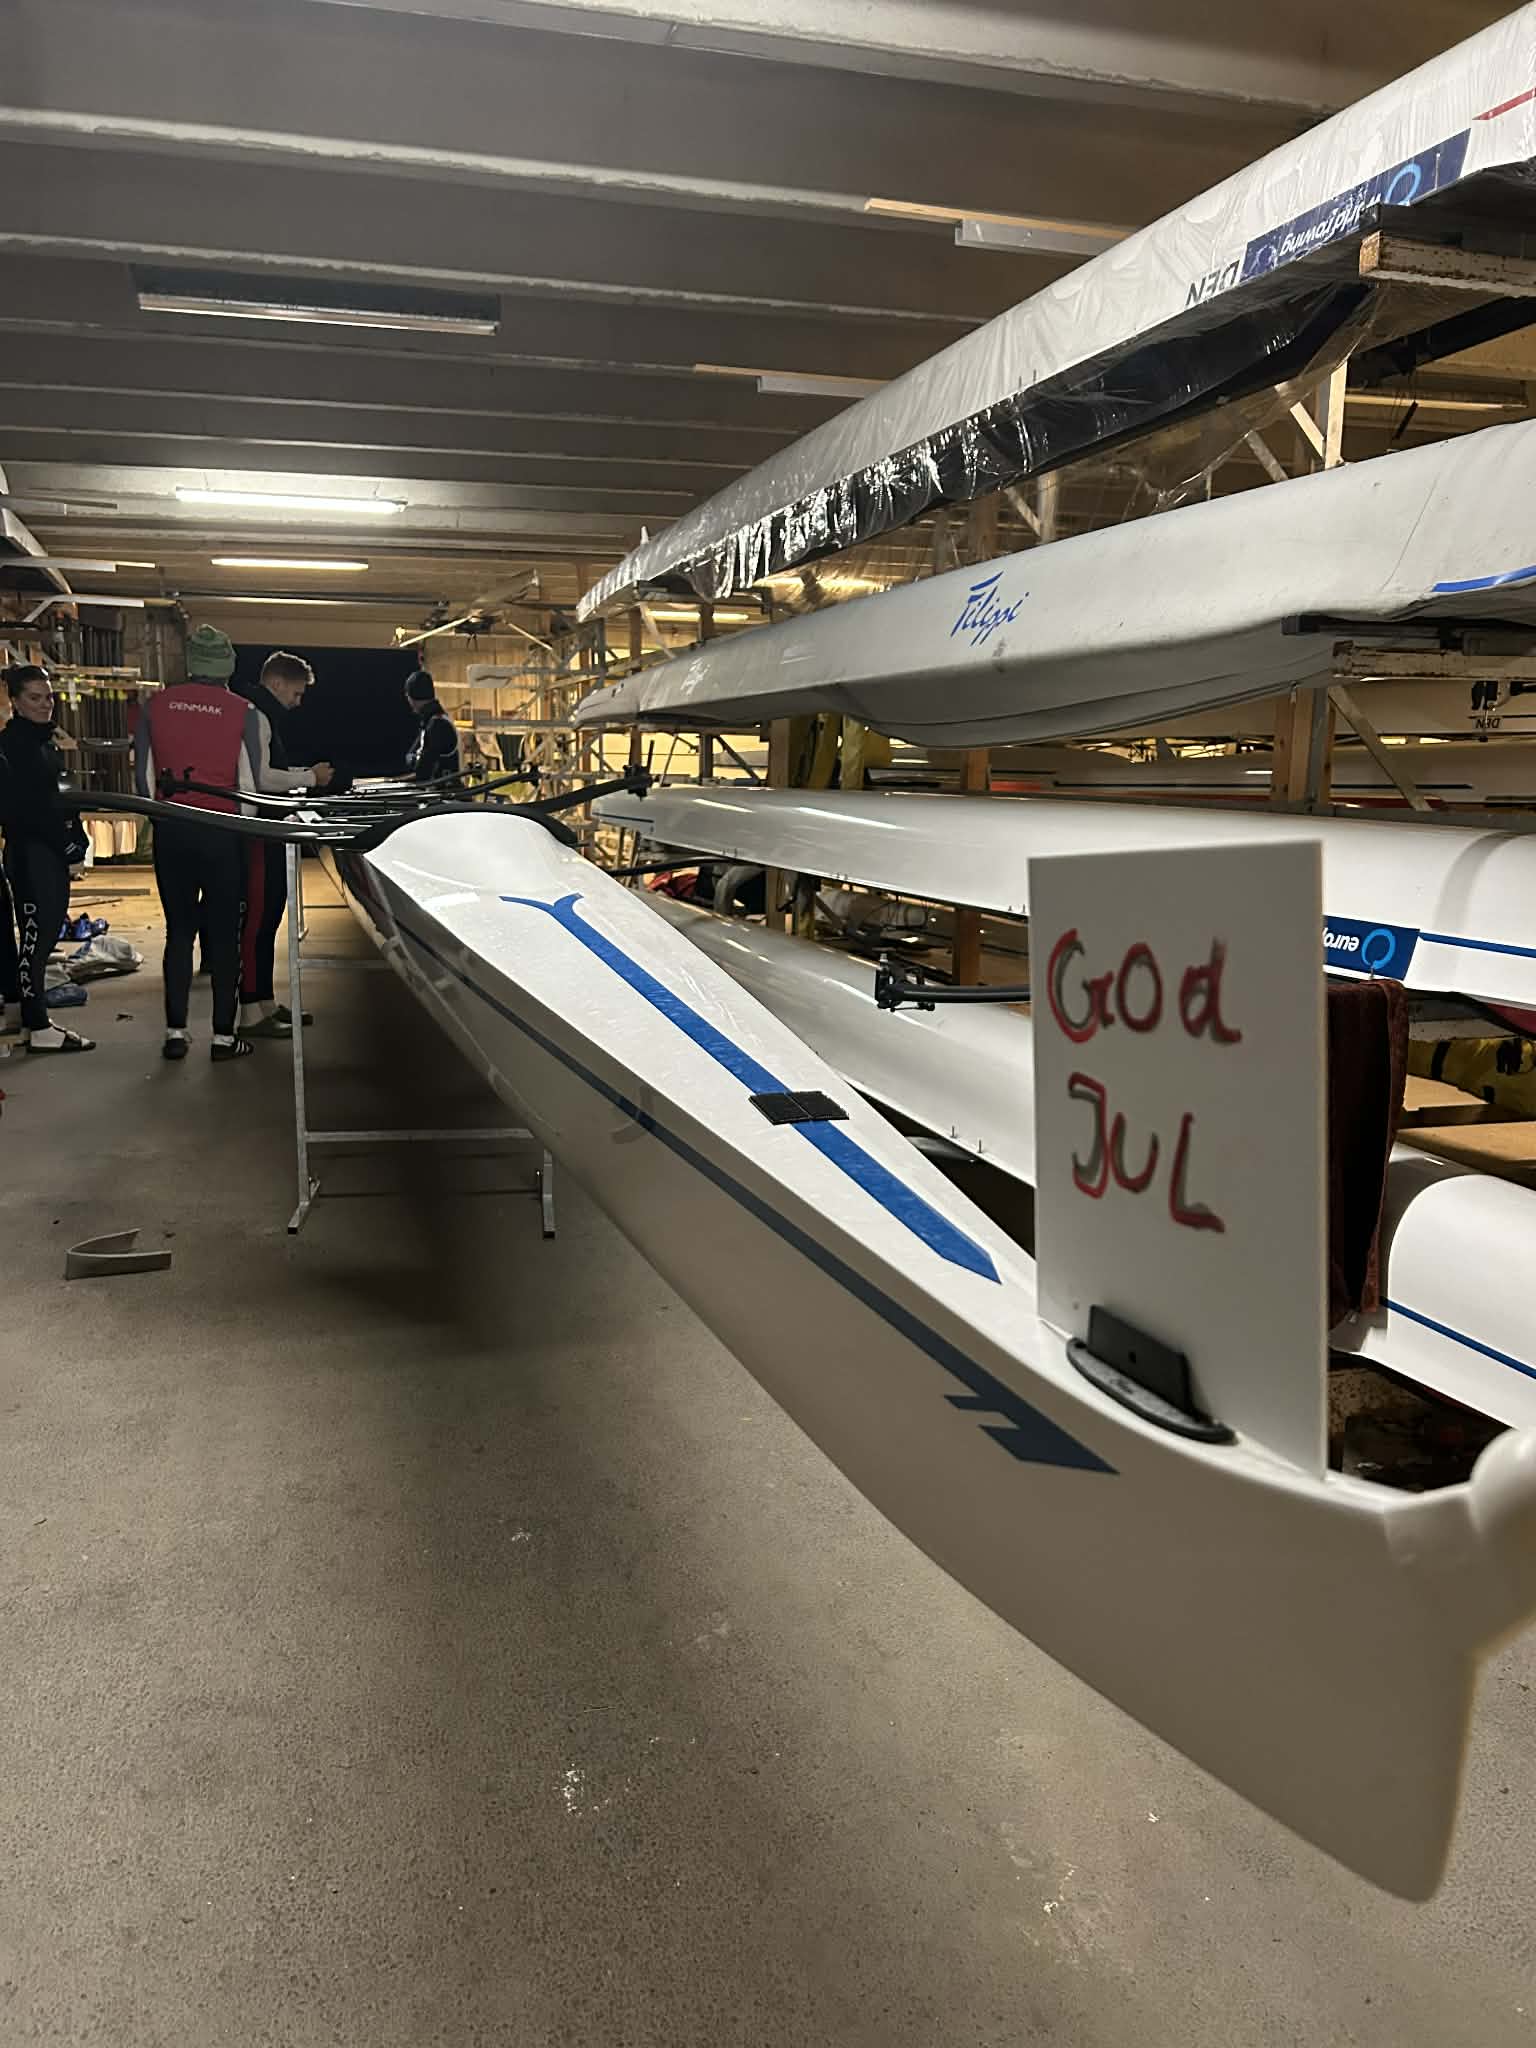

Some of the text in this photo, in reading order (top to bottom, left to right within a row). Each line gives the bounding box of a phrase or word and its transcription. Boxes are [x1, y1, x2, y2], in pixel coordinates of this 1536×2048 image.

[1186, 259, 1240, 306] DEN
[950, 571, 1030, 647] Filippi
[168, 701, 222, 716] DENMARK
[18, 902, 39, 999] DANMARK
